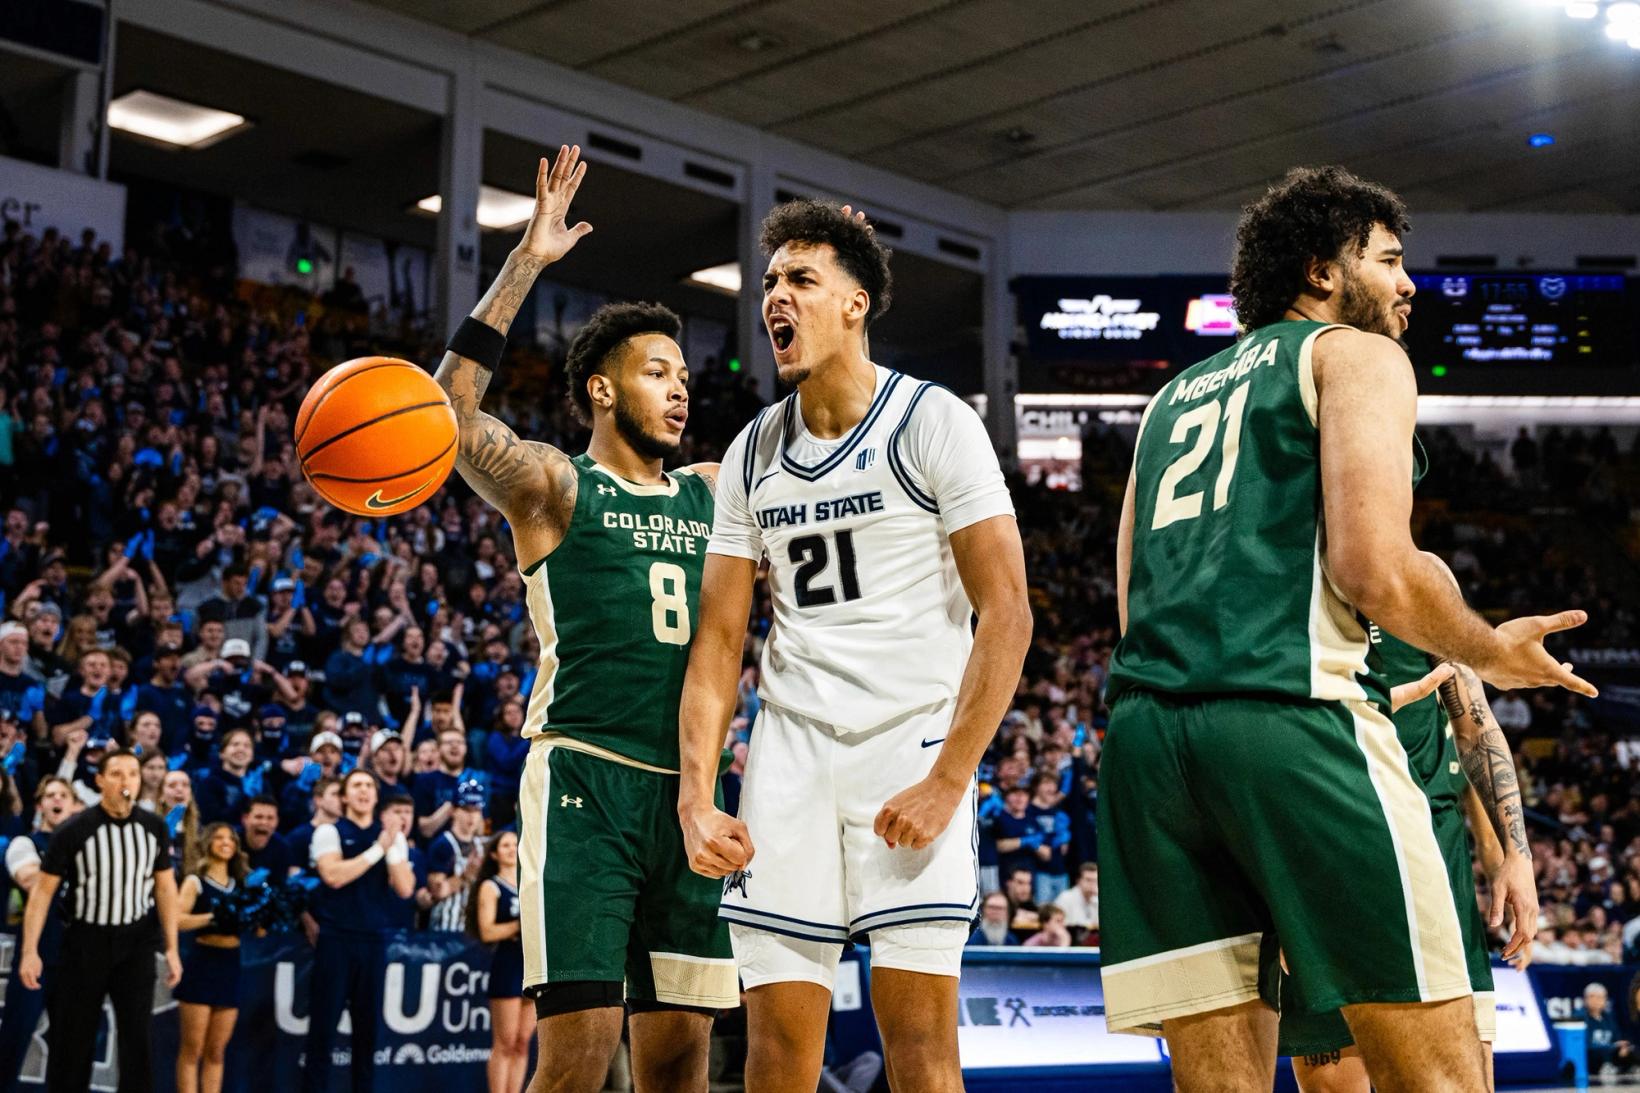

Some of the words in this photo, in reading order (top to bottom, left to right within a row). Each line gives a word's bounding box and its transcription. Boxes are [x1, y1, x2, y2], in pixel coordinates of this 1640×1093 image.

[1168, 338, 1279, 406] MBEMBA
[1151, 379, 1251, 530] 21
[603, 511, 711, 541] COLORADO
[633, 531, 697, 555] STATE
[755, 503, 807, 529] UTAH
[814, 490, 884, 523] STATE
[787, 528, 862, 609] 21
[649, 561, 692, 646] 8
